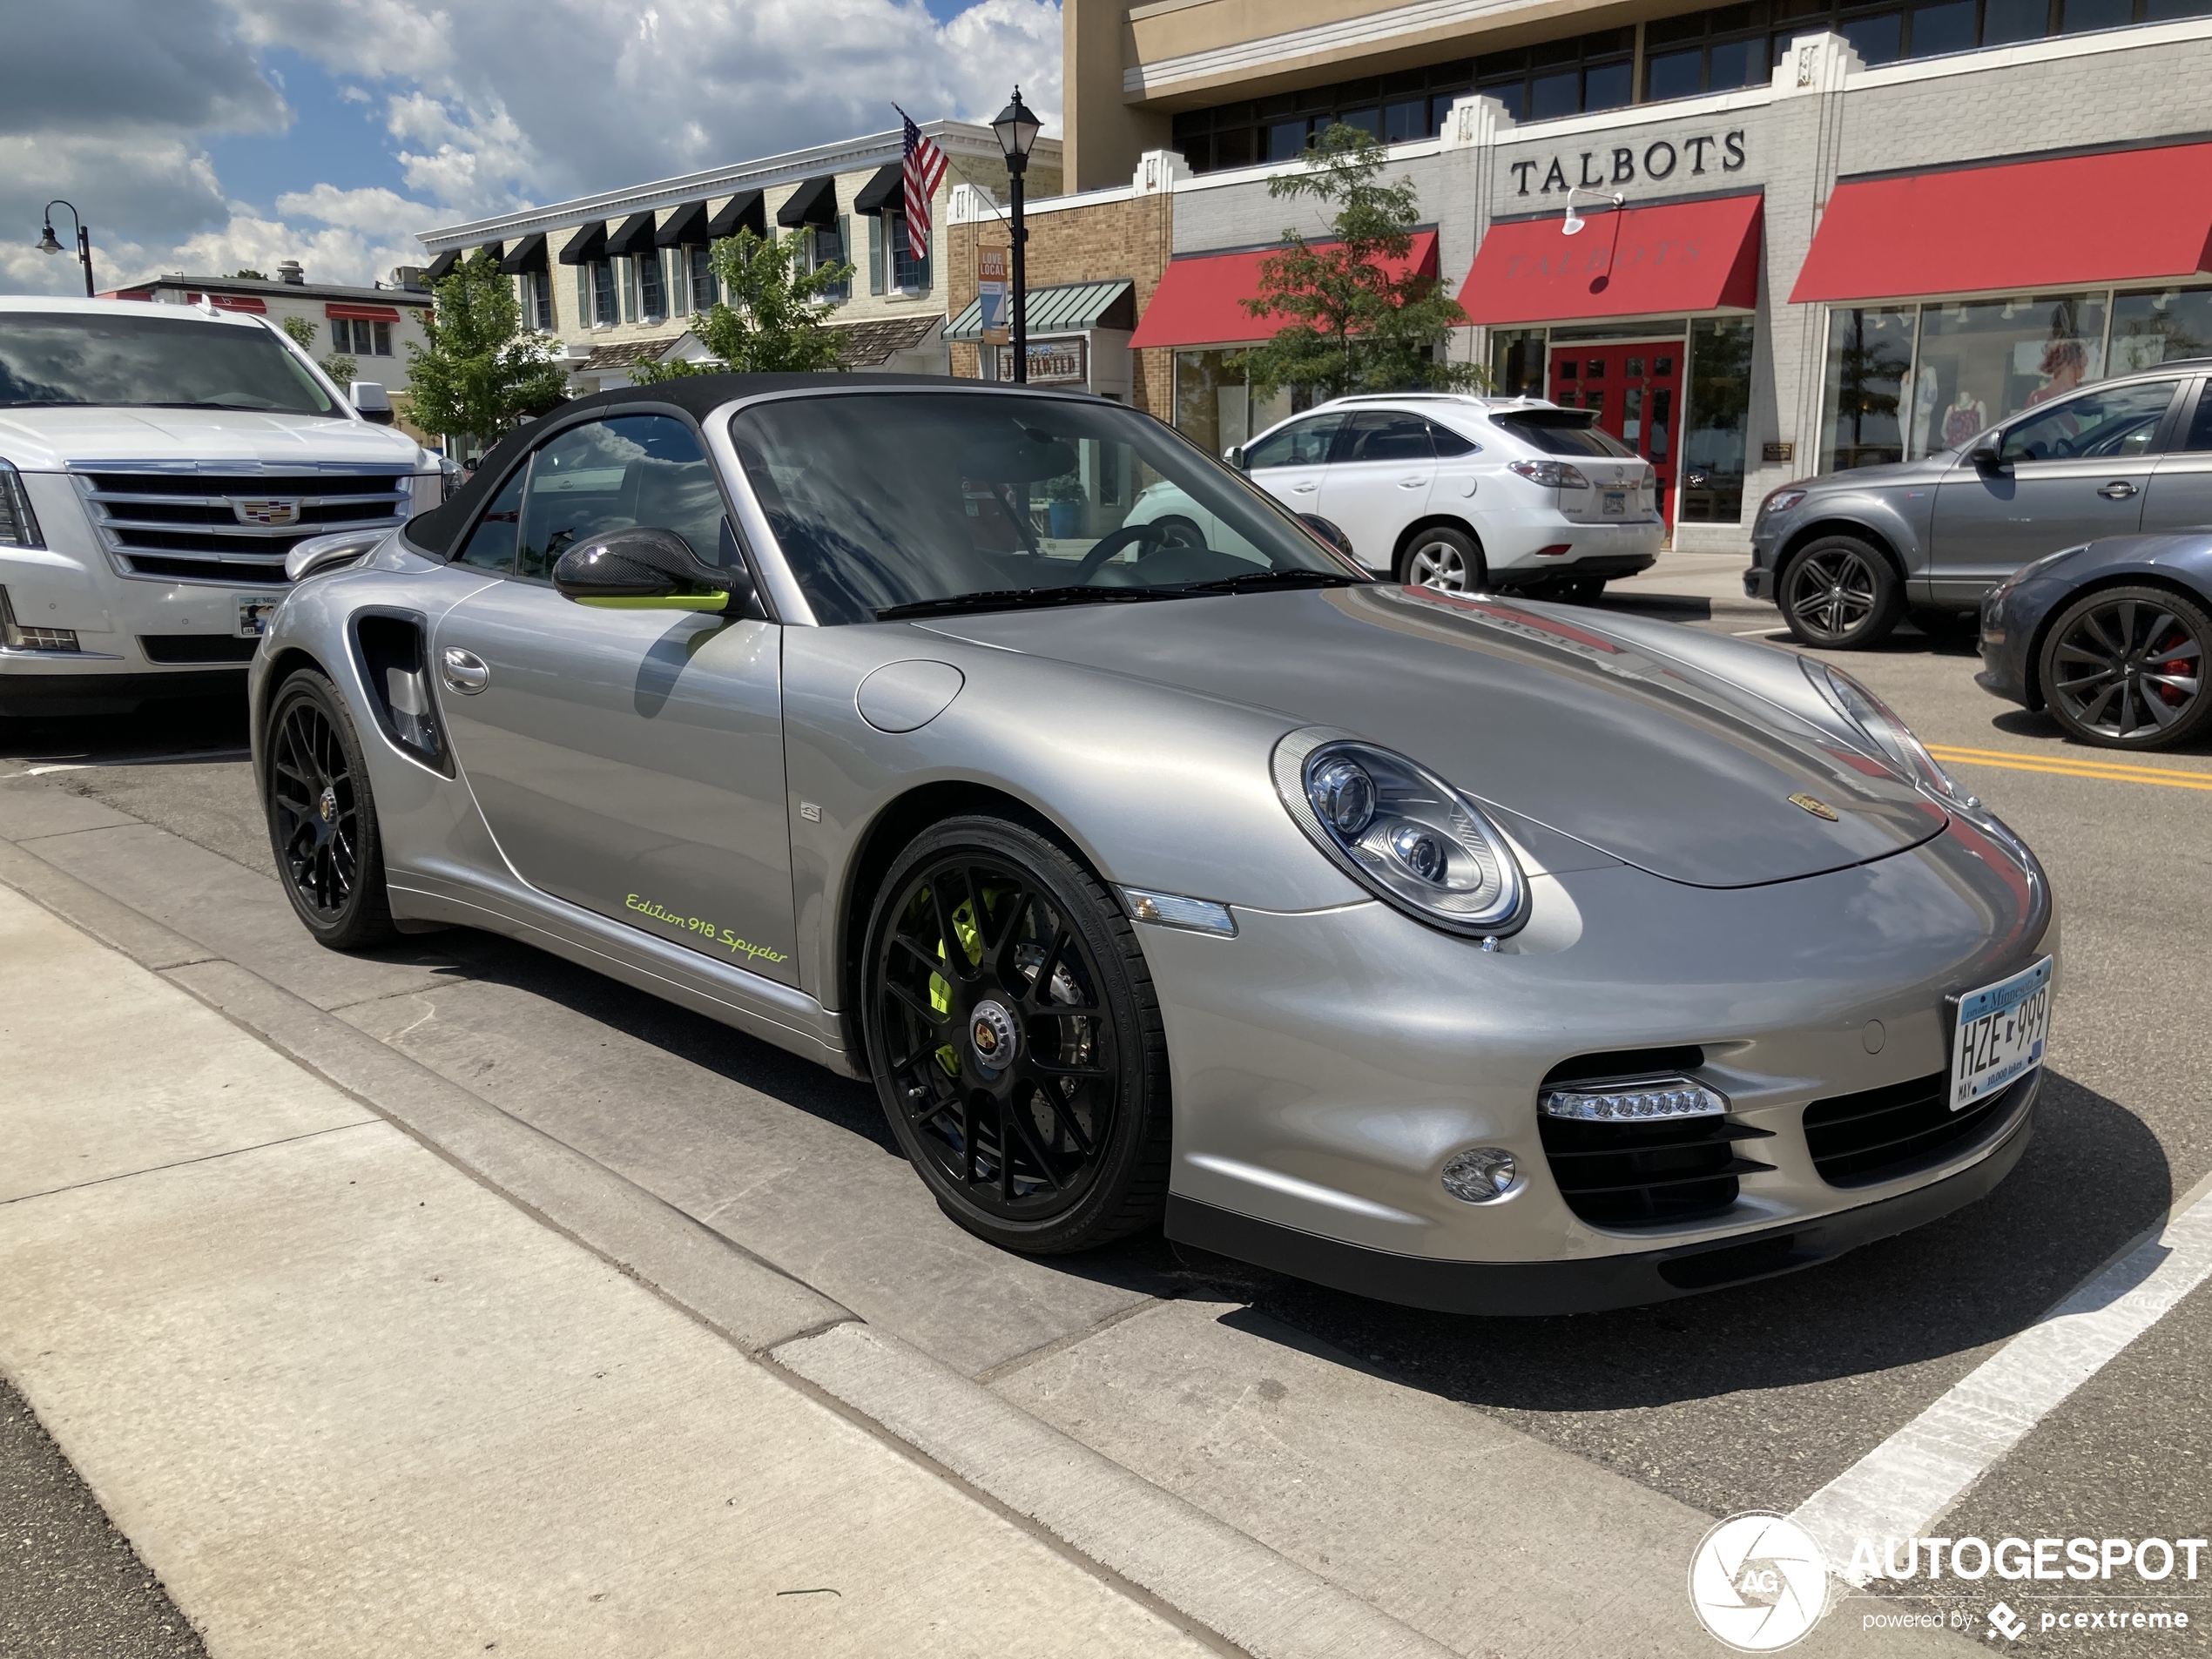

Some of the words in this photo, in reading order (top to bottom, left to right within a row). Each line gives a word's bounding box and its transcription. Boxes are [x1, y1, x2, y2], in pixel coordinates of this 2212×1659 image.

[1511, 130, 1746, 196] TALBOTS
[980, 264, 1005, 275] LOCAL
[982, 253, 1002, 265] LOVE
[1504, 239, 1704, 280] TALBOTS
[1003, 354, 1076, 380] JELWEED
[625, 894, 685, 928] Edition
[688, 917, 716, 938] 918
[717, 929, 788, 963] Spyder
[1966, 1004, 1987, 1019] EXPLORE
[1959, 1010, 2006, 1080] HZE
[2017, 987, 2046, 1052] 999
[1986, 1067, 2007, 1087] 10,000
[2008, 1060, 2022, 1075] lakes
[1958, 1081, 1972, 1102] MAY
